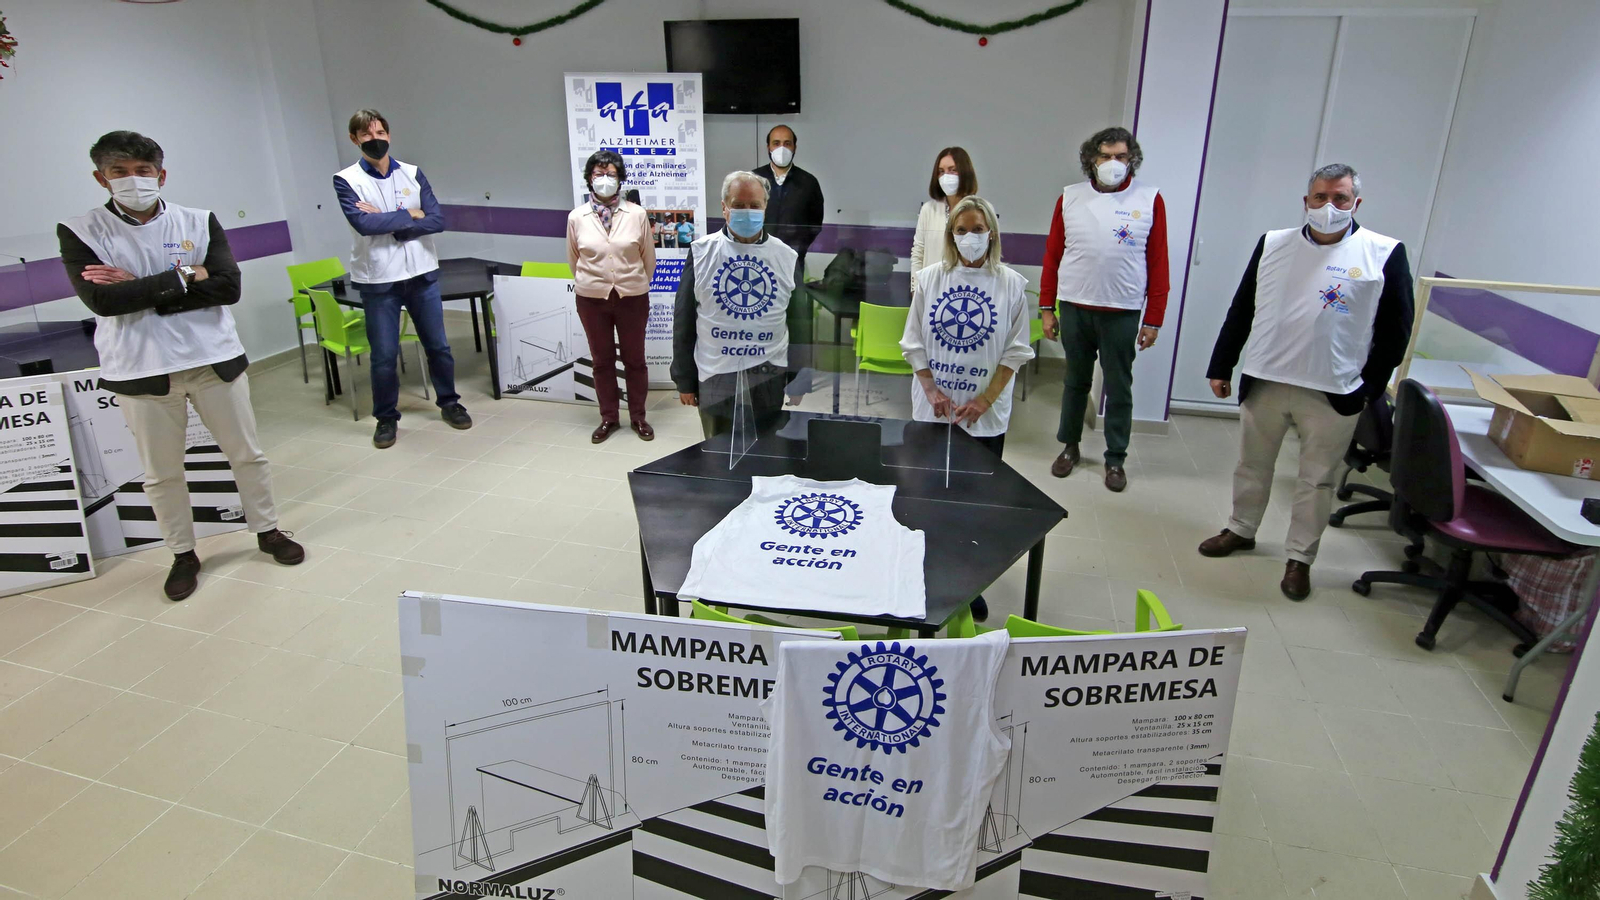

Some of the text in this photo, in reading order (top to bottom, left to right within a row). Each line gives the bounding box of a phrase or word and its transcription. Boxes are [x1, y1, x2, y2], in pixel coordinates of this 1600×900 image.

[599, 90, 671, 129] afa
[600, 138, 676, 146] ALZHEIMER
[731, 261, 761, 271] ROTARY
[1325, 265, 1348, 274] Rotary
[952, 291, 981, 301] ROTARY
[722, 296, 769, 313] INTERNATIONAL
[711, 327, 774, 341] Gente en
[936, 325, 986, 346] INTERNATIONAL
[721, 344, 766, 356] acción
[929, 358, 989, 377] Gente en
[935, 377, 978, 392] acción
[19, 391, 48, 406] DE
[786, 517, 849, 533] INTERNATIONAL
[760, 541, 857, 558] Gente en
[772, 556, 843, 571] acción
[610, 629, 769, 666] MAMPARA
[867, 654, 919, 672] ROTARY
[1021, 645, 1226, 677] MAMPARA DE
[1044, 678, 1219, 708] SOBREMESA
[501, 695, 533, 707] 100 cm
[839, 709, 923, 743] INTERNATIONAL
[1131, 717, 1169, 725] Mampara:
[1174, 714, 1188, 722] 100
[1193, 713, 1203, 721] 80
[667, 722, 691, 731] Altura
[693, 725, 727, 735] soportes
[1134, 723, 1174, 732] Ventanilla:
[1069, 736, 1093, 744] Altura
[1095, 734, 1129, 743] soportes
[1130, 730, 1190, 740] estabilizadores:
[1191, 728, 1201, 736] 35
[691, 740, 735, 750] Metacrilato
[1092, 742, 1210, 757] Metacrilato transparente (3mm)
[631, 755, 644, 764] 80
[681, 753, 722, 764] Contenido:
[1079, 764, 1120, 773] Contenido:
[1176, 757, 1208, 766] soportes
[692, 763, 748, 775] Automontable,
[807, 756, 924, 795] Gente en
[1146, 767, 1163, 775] fácil
[721, 773, 758, 784] Despegar
[1029, 776, 1041, 784] 80
[1117, 776, 1153, 785] Despegar
[823, 787, 905, 819] acción
